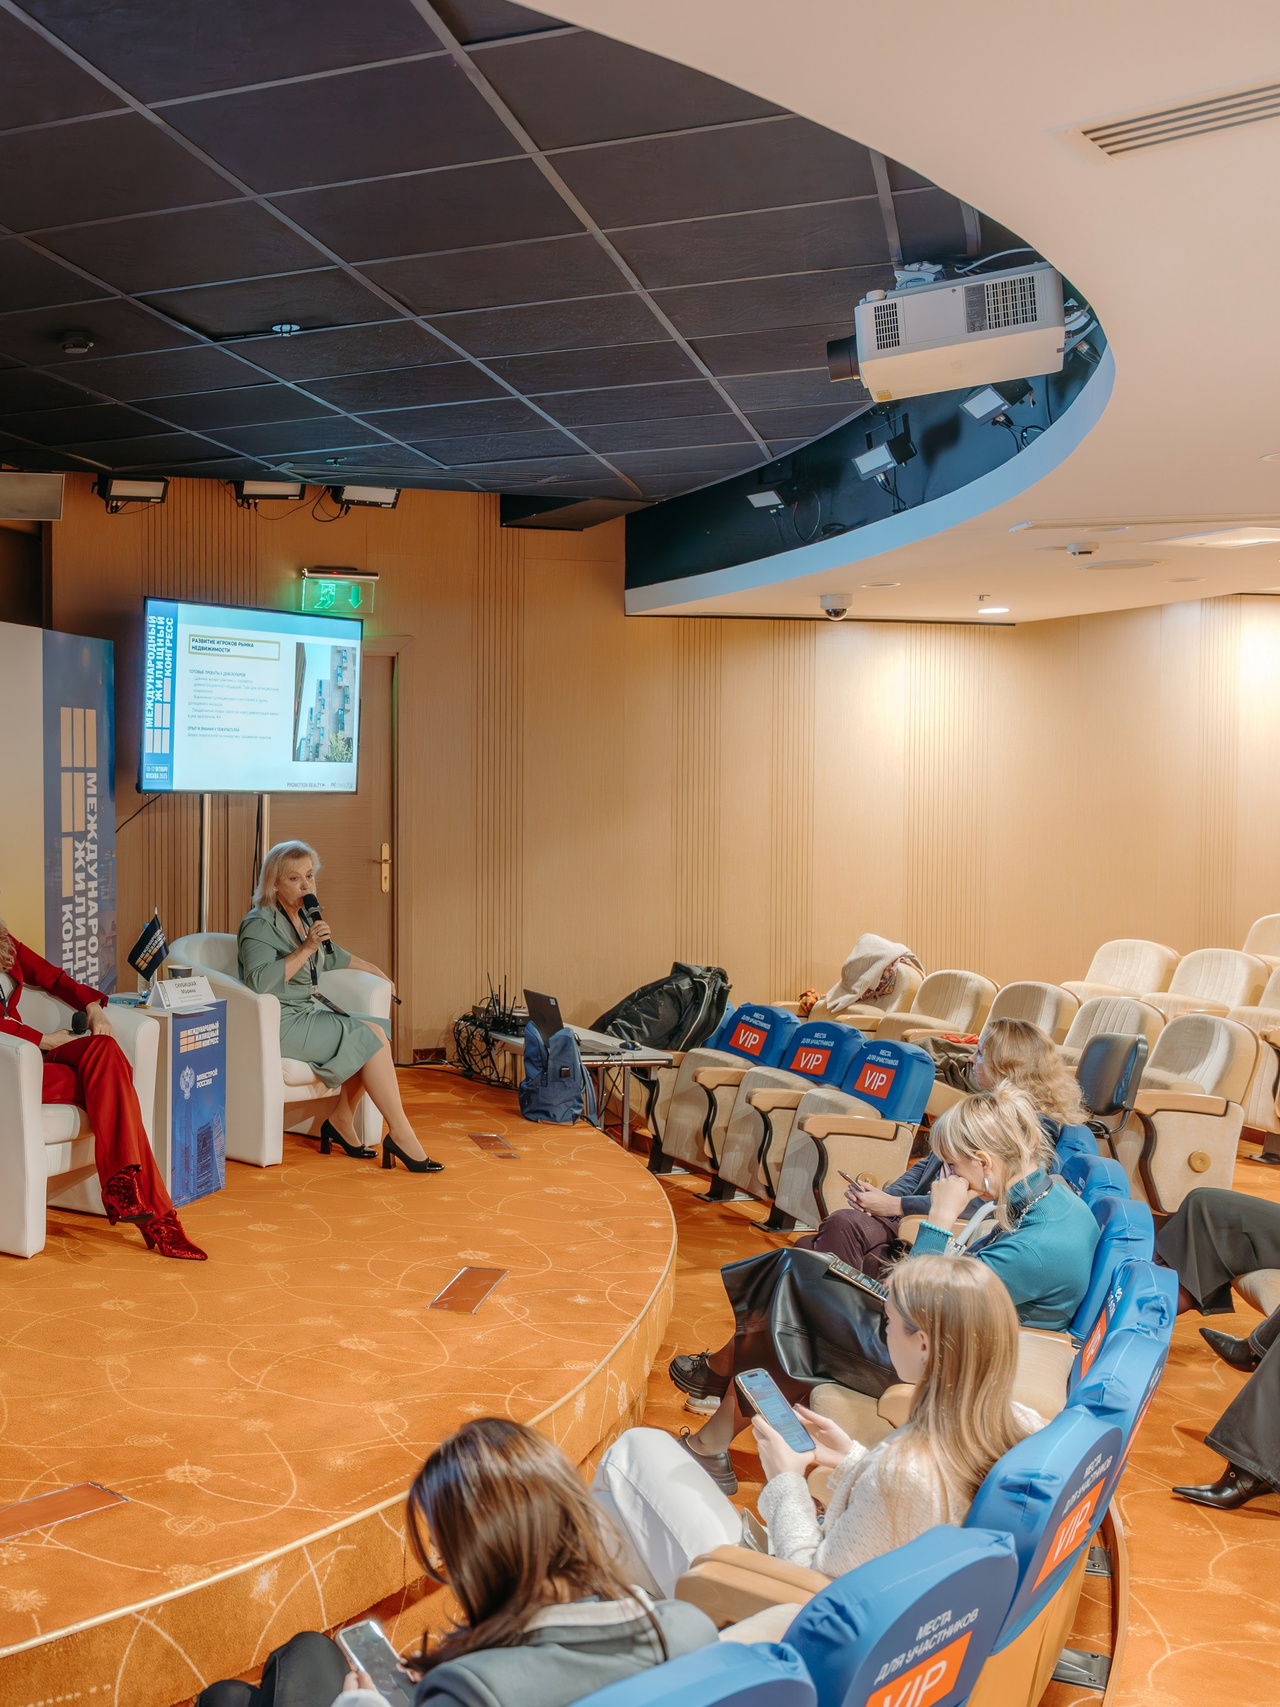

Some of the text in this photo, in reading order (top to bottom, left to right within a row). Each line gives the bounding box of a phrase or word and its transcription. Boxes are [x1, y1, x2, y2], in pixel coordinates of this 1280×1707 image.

[145, 615, 157, 727] МЕЖДУНАРОДНЫЙ
[155, 616, 166, 702] ЖИЛИЩНЫЙ
[164, 617, 174, 677] КОНГРЕСС
[192, 645, 231, 653] НЕДВИЖИМОСТИ
[85, 772, 99, 990] МЕЖДУНАРОДН
[61, 903, 74, 977] КОНГ
[74, 839, 87, 984] ЖИЛИЩН
[738, 1029, 760, 1048] VIP
[800, 1052, 823, 1070] VIP
[197, 1078, 212, 1088] РОССИИ
[864, 1069, 887, 1091] VIP
[1053, 1500, 1091, 1561] VIP
[873, 1608, 979, 1687] ДЛЯ УЧАСТНИКОВ
[915, 1609, 952, 1642] МЕСТА
